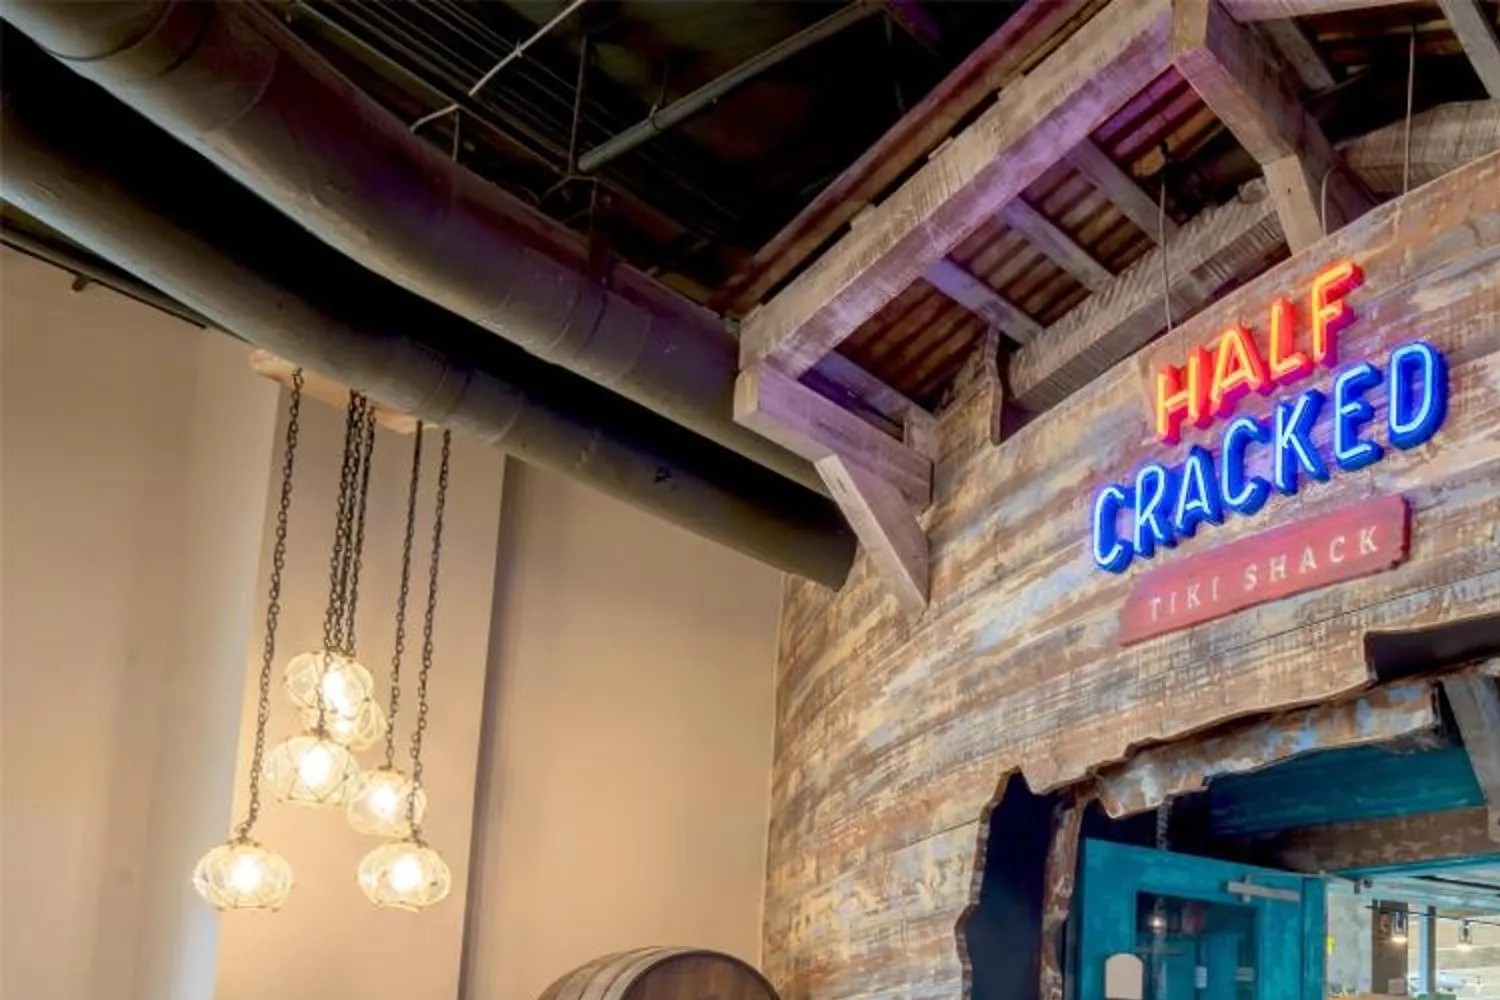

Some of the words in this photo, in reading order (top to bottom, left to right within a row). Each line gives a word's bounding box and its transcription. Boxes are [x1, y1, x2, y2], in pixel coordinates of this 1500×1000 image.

[1155, 256, 1364, 445] HALF
[1091, 341, 1449, 574] CRACKED
[1149, 576, 1221, 622] TIKI
[1244, 524, 1380, 593] SHACK
